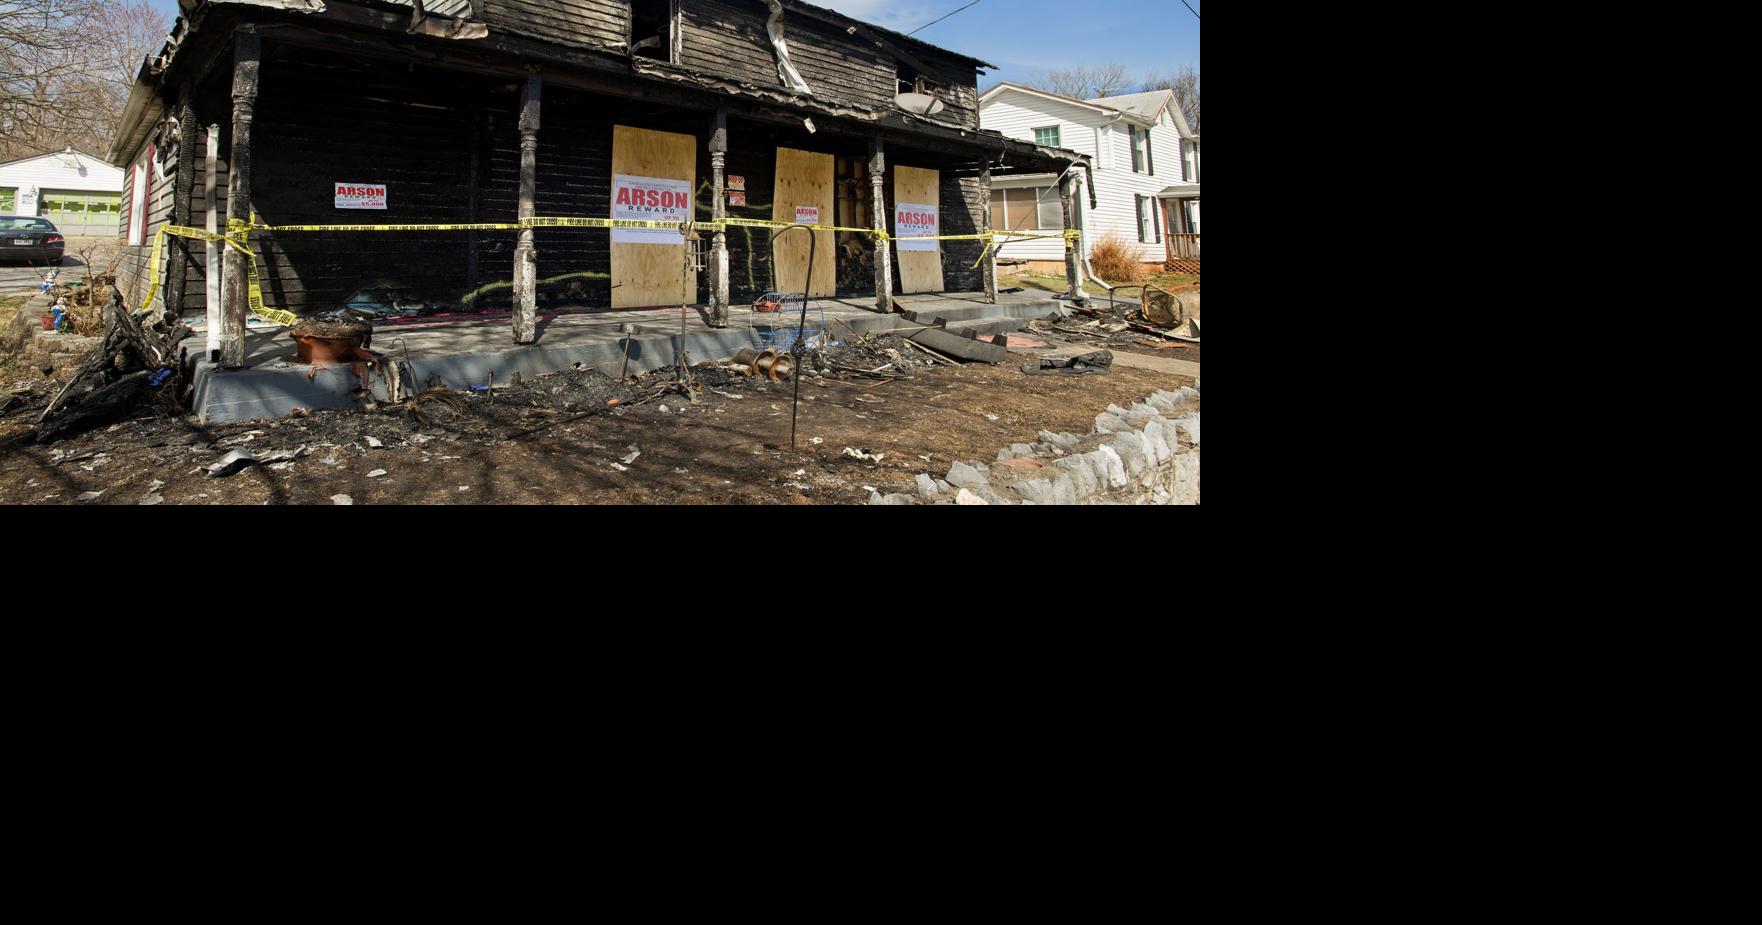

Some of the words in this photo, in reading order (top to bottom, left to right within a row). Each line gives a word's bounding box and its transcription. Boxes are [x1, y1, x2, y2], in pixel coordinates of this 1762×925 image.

[336, 186, 385, 197] ARSON
[616, 187, 688, 209] ARSON
[628, 205, 675, 214] REWARD
[796, 208, 818, 216] ARSON
[897, 211, 935, 226] ARSON
